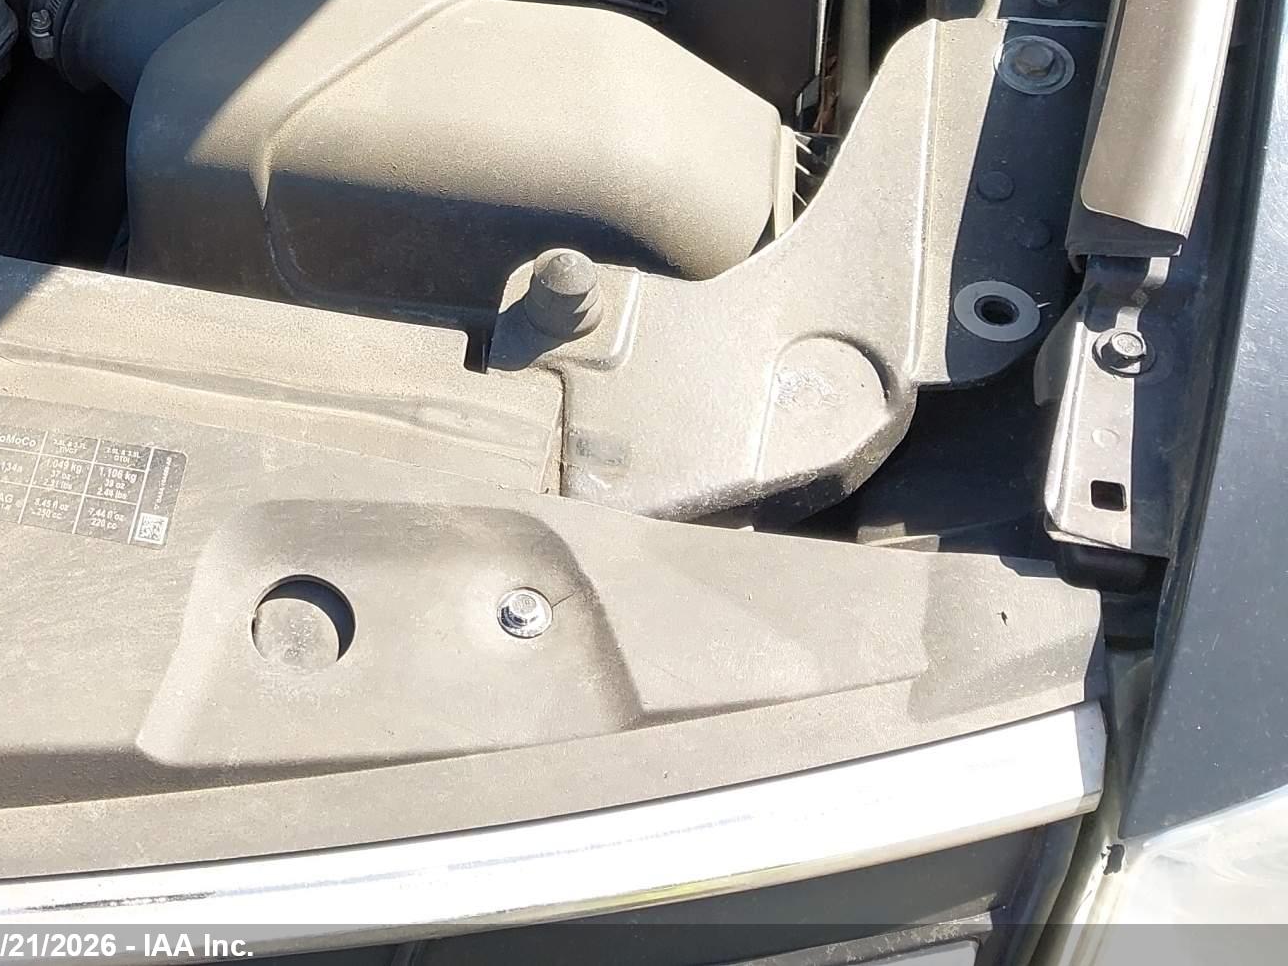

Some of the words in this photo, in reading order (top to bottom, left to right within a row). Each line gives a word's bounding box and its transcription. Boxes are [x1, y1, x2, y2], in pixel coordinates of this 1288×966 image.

[46, 458, 70, 470] 1.049
[70, 462, 83, 474] kg
[50, 469, 61, 478] 37
[99, 466, 124, 479] 1.106
[124, 470, 138, 483] kg
[60, 481, 73, 490] lbs
[115, 482, 126, 490] oz
[114, 489, 128, 500] lbs
[59, 503, 70, 511] oz
[51, 511, 62, 520] cc
[87, 507, 106, 518] 7.44
[114, 514, 125, 522] oz
[106, 521, 118, 530] cc
